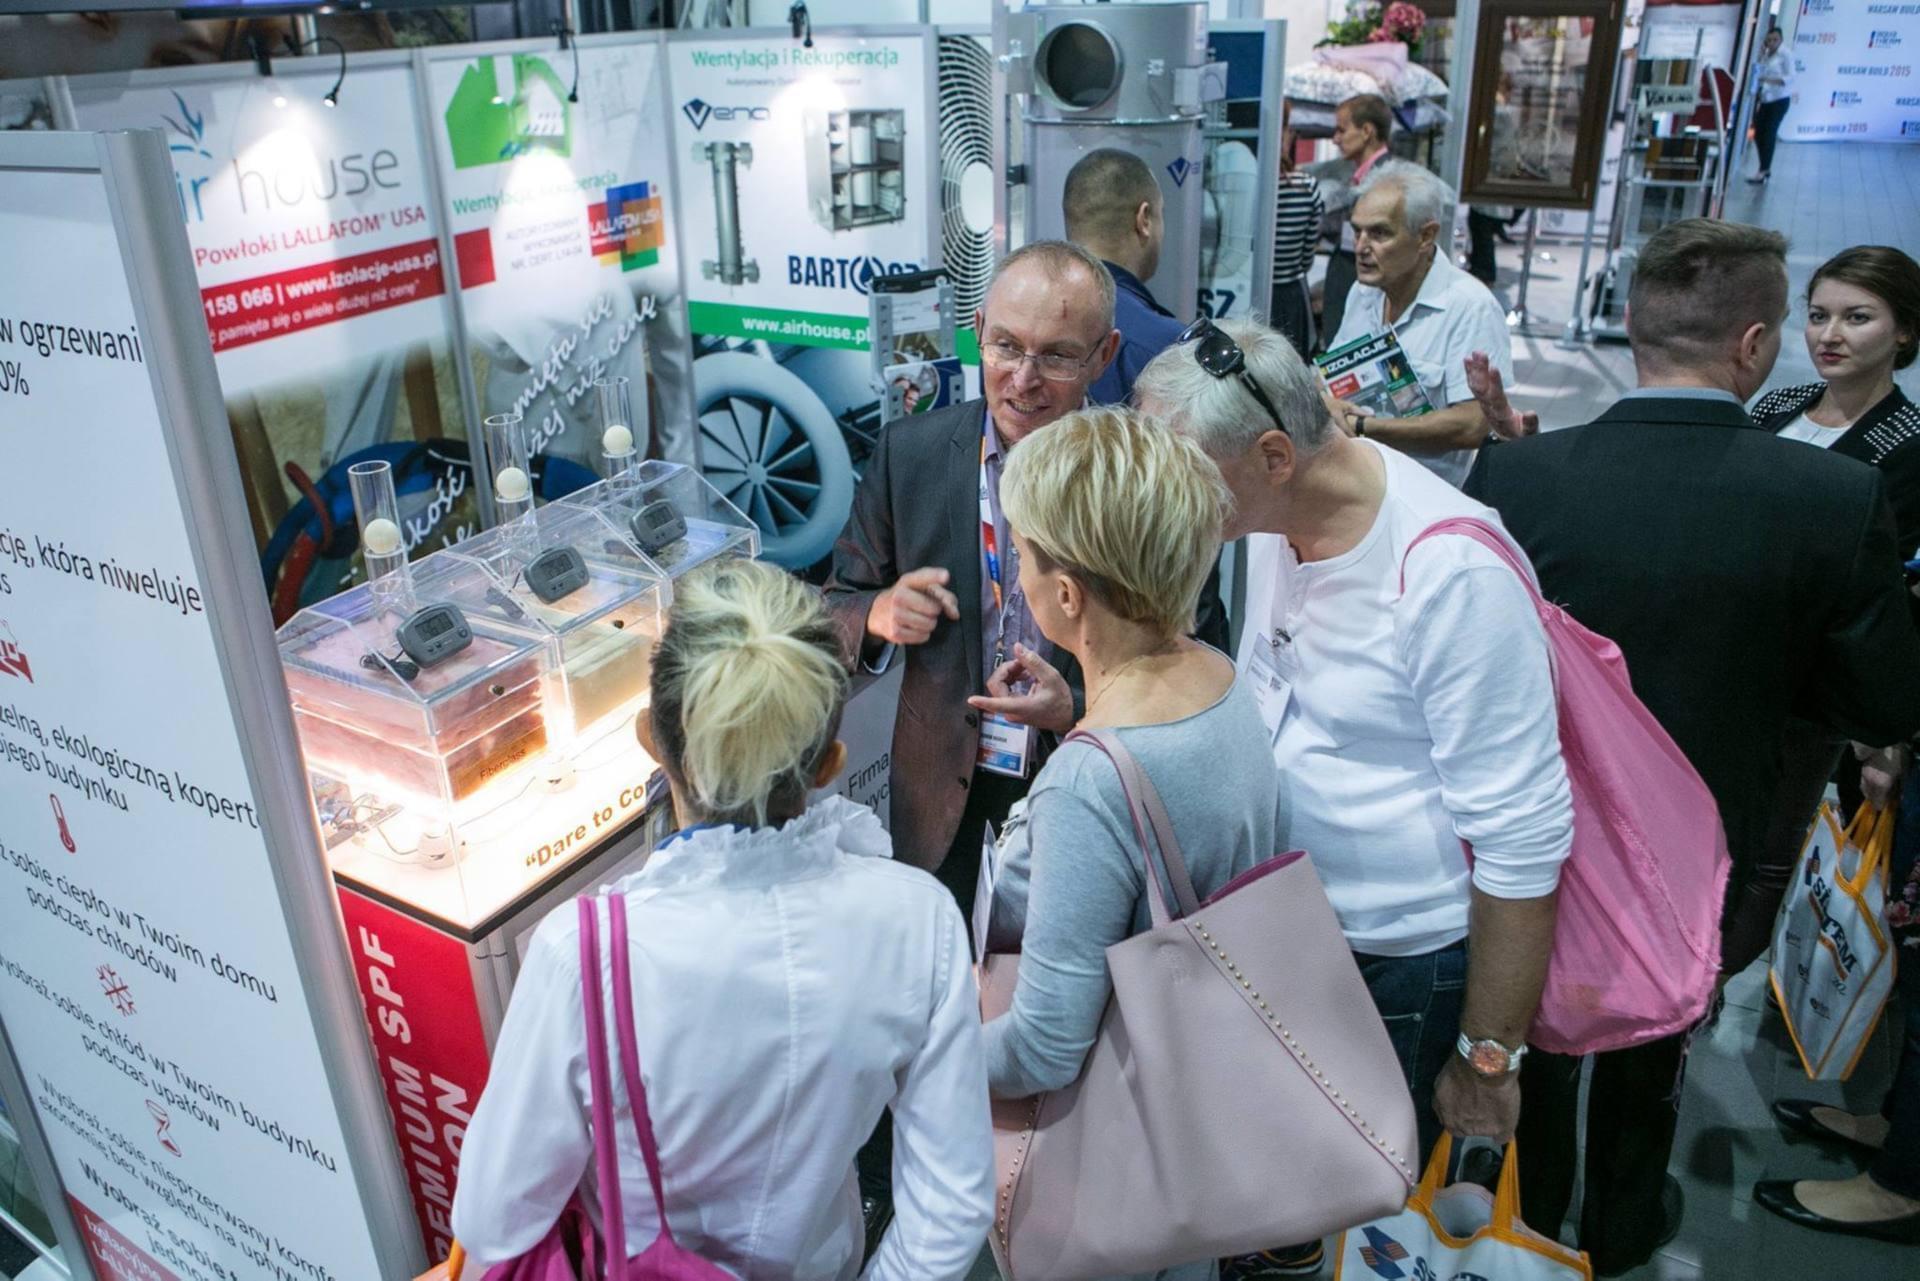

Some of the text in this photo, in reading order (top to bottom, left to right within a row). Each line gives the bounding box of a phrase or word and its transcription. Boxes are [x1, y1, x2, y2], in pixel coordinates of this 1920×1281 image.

[691, 46, 899, 71] Wentylacja i Rekuperacja
[195, 232, 278, 267] Powłoki
[391, 205, 426, 229] USA
[205, 293, 239, 319] 158
[741, 315, 871, 345] www.airhouse.pl
[1326, 338, 1388, 374] IZOLACJE
[403, 464, 465, 551] kość
[0, 528, 203, 616] cję, która niweluje
[42, 750, 129, 812] budynku
[52, 725, 175, 802] ekologiczną
[848, 752, 889, 798] Firma
[592, 807, 613, 828] to
[9, 849, 54, 887] sobie
[57, 873, 111, 918] ciepło
[114, 906, 132, 930] w
[134, 911, 206, 968] Twoim
[210, 952, 278, 1003] domu
[26, 885, 178, 983] podczas chłodów
[359, 926, 412, 1044] SPF
[52, 992, 96, 1030] sobie
[98, 1020, 147, 1062] chłód
[149, 1053, 166, 1074] w
[167, 1061, 237, 1118] Twoim
[239, 1101, 338, 1174] budynku
[82, 1032, 220, 1132] podczas upałów
[140, 1171, 211, 1231] względu
[213, 1223, 237, 1248] na
[151, 1158, 271, 1252] nieprzerwany
